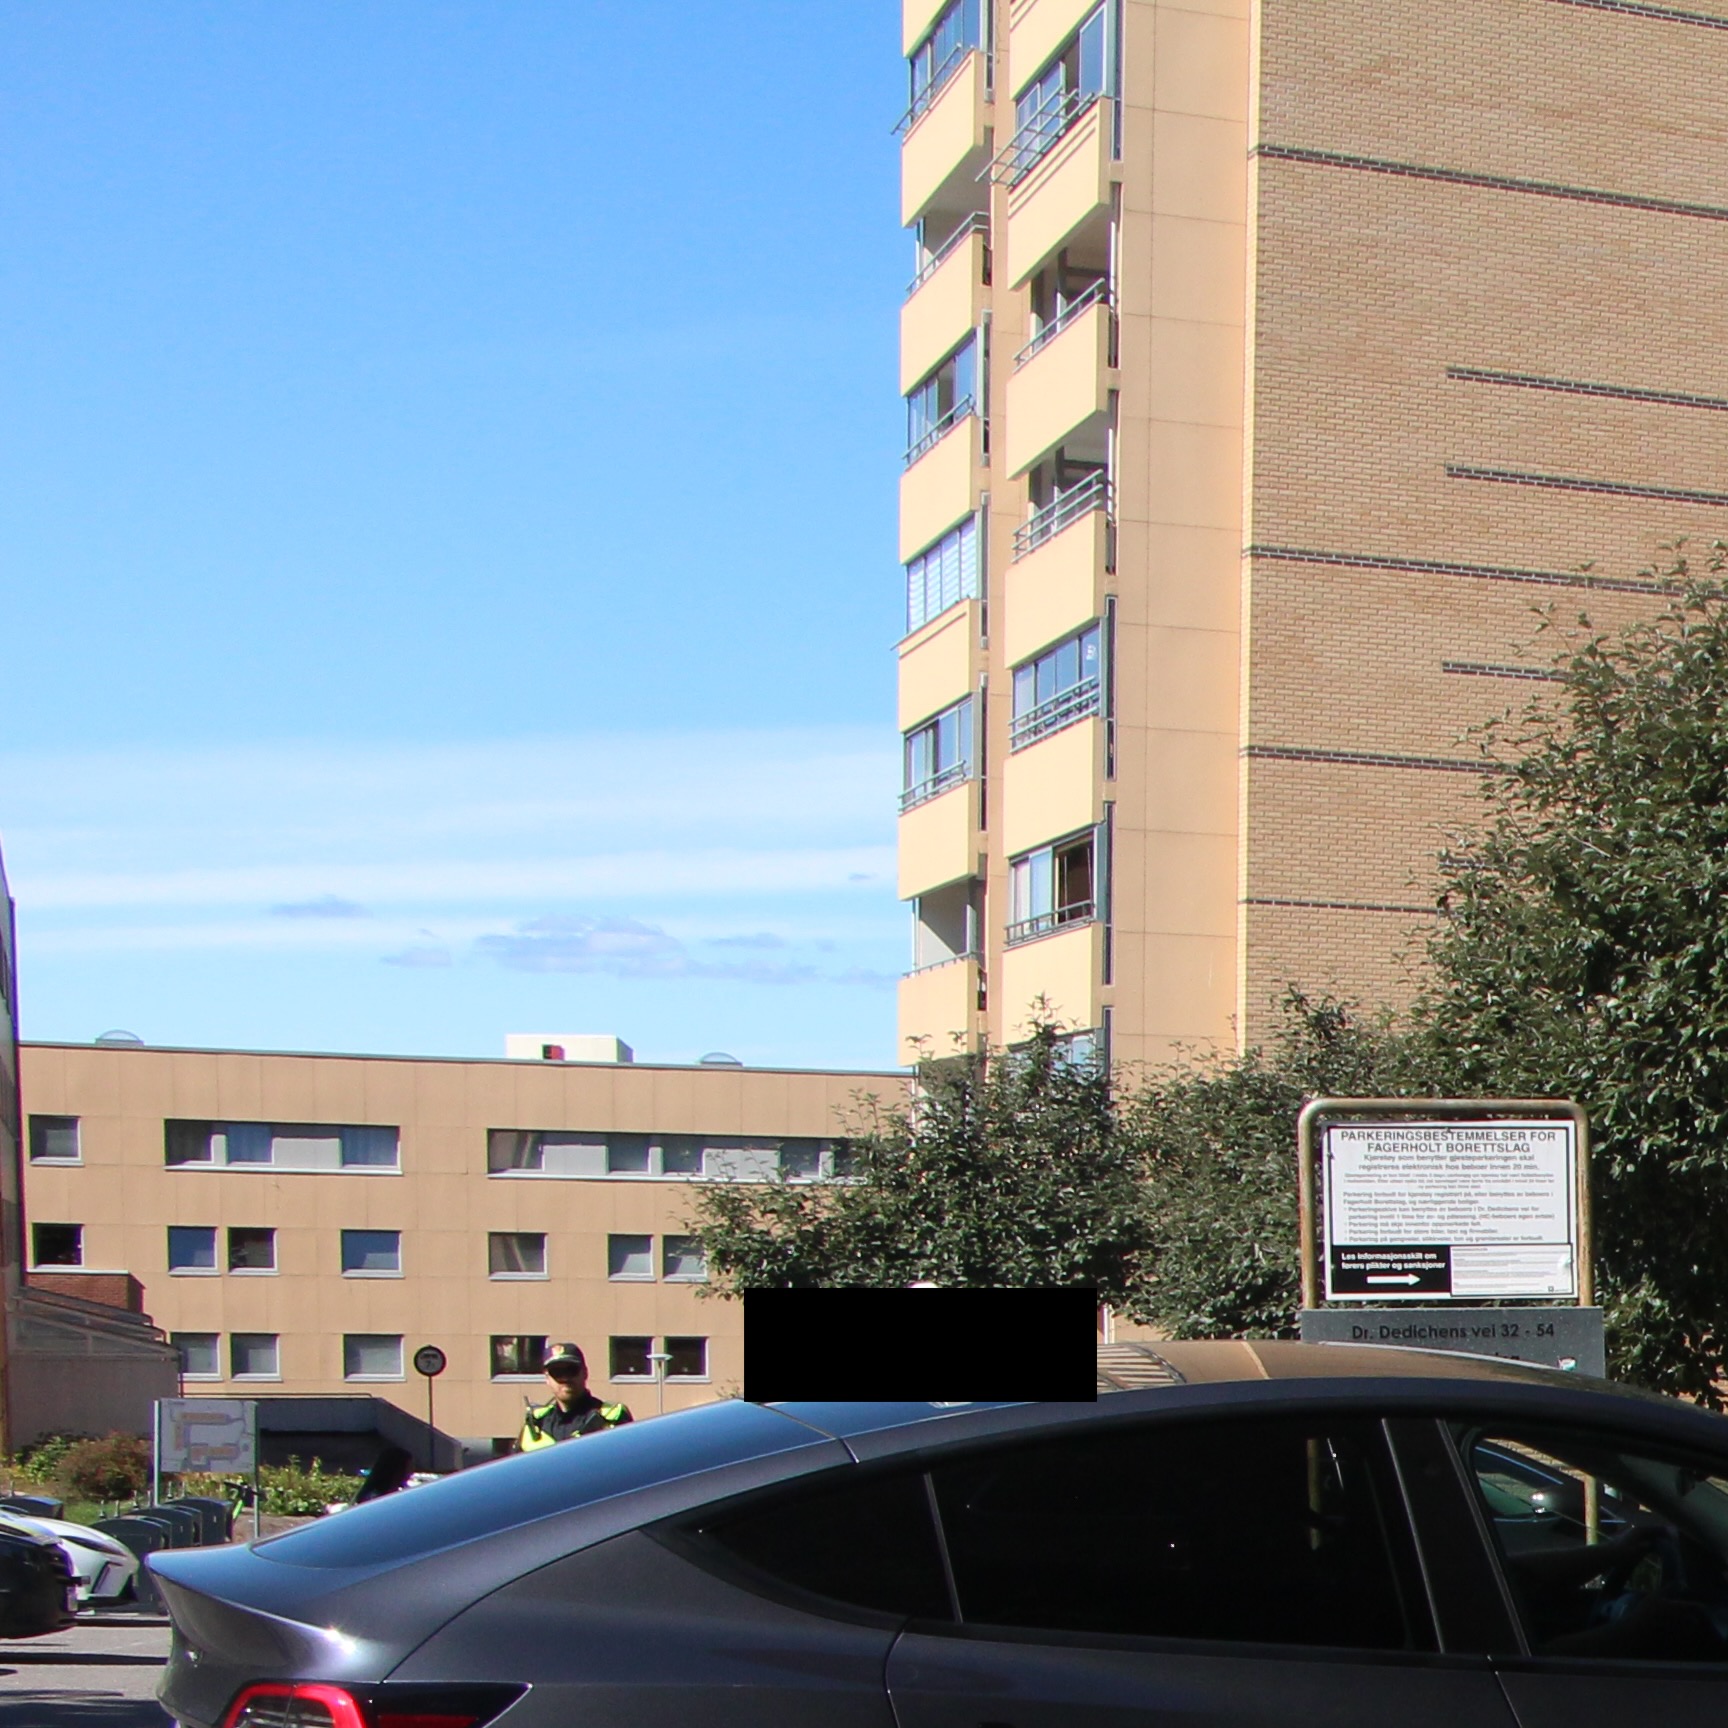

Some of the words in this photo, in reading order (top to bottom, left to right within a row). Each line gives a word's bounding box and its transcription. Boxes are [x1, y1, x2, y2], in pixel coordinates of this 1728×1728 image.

[1340, 1131, 1526, 1141] PARKERINGSBESTEMMELSER
[1530, 1131, 1556, 1141] FOR
[1367, 1142, 1442, 1153] FAGERHOLT
[1446, 1142, 1531, 1153] BORETTSLAG
[1341, 1252, 1356, 1260] Les
[1391, 1262, 1402, 1271] og
[1352, 1325, 1373, 1340] Dr.
[1379, 1324, 1467, 1340] Dedichens
[1471, 1324, 1496, 1338] vei
[1500, 1323, 1519, 1338] 32
[1536, 1323, 1554, 1337] 54
